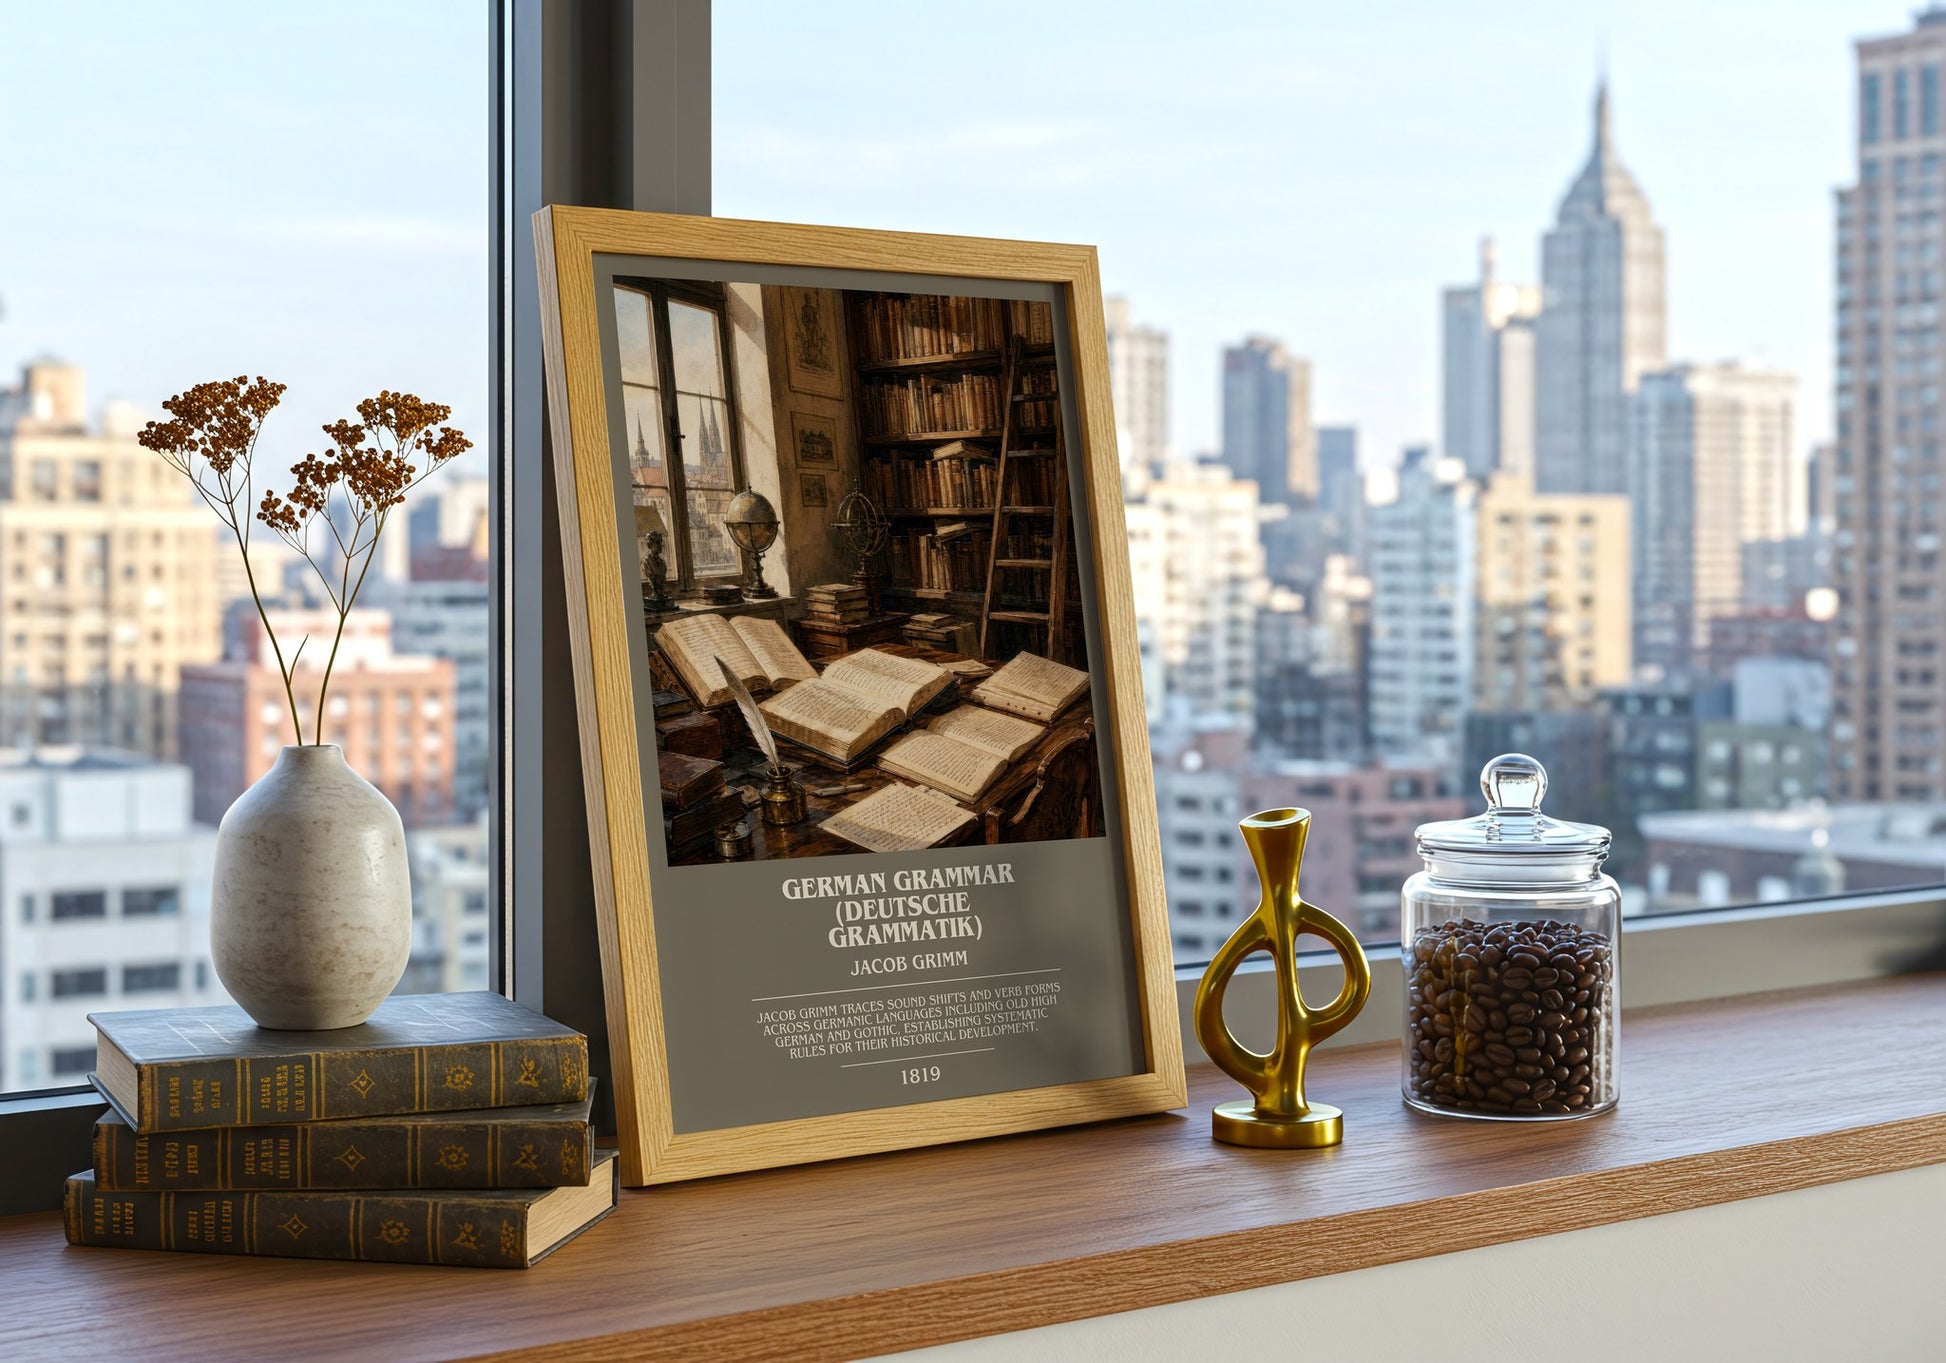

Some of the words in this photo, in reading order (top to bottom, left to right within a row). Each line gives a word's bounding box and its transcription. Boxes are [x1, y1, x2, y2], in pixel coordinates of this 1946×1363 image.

[782, 872, 887, 900] GERMAN
[894, 863, 1015, 891] GRAMMAR
[836, 892, 970, 926] (DEUTSCHE
[828, 916, 982, 948] GRAMMATIK)
[850, 956, 907, 976] JACOB
[912, 951, 968, 970] GRIMM
[756, 1010, 796, 1024] JACOB
[800, 1005, 837, 1018] GRIMM
[840, 1000, 884, 1015] TRACES
[887, 996, 926, 1010] SOUND
[929, 992, 966, 1006] SHIFTS
[969, 989, 991, 1002] AND
[995, 986, 1022, 999] VERB
[1025, 982, 1061, 995] FORMS
[763, 1022, 811, 1036] ACROSS
[814, 1015, 873, 1030] GERMANIC
[876, 1007, 942, 1024] LANGUAGES
[945, 1000, 1003, 1016] INCLUDING
[1006, 997, 1028, 1010] OLD
[1031, 995, 1057, 1006] HIGH
[775, 1033, 823, 1048] GERMAN
[827, 1030, 850, 1042] AND
[854, 1024, 900, 1039] GOTHIC,
[904, 1015, 981, 1034] ESTABLISHING
[984, 1008, 1048, 1024] SYSTEMATIC
[790, 1045, 826, 1059] RULES
[829, 1042, 853, 1055] FOR
[855, 1038, 888, 1052] THEIR
[891, 1031, 956, 1047] HISTORICAL
[959, 1021, 1039, 1041] DEVELOPMENT.
[901, 1066, 940, 1085] 1819
